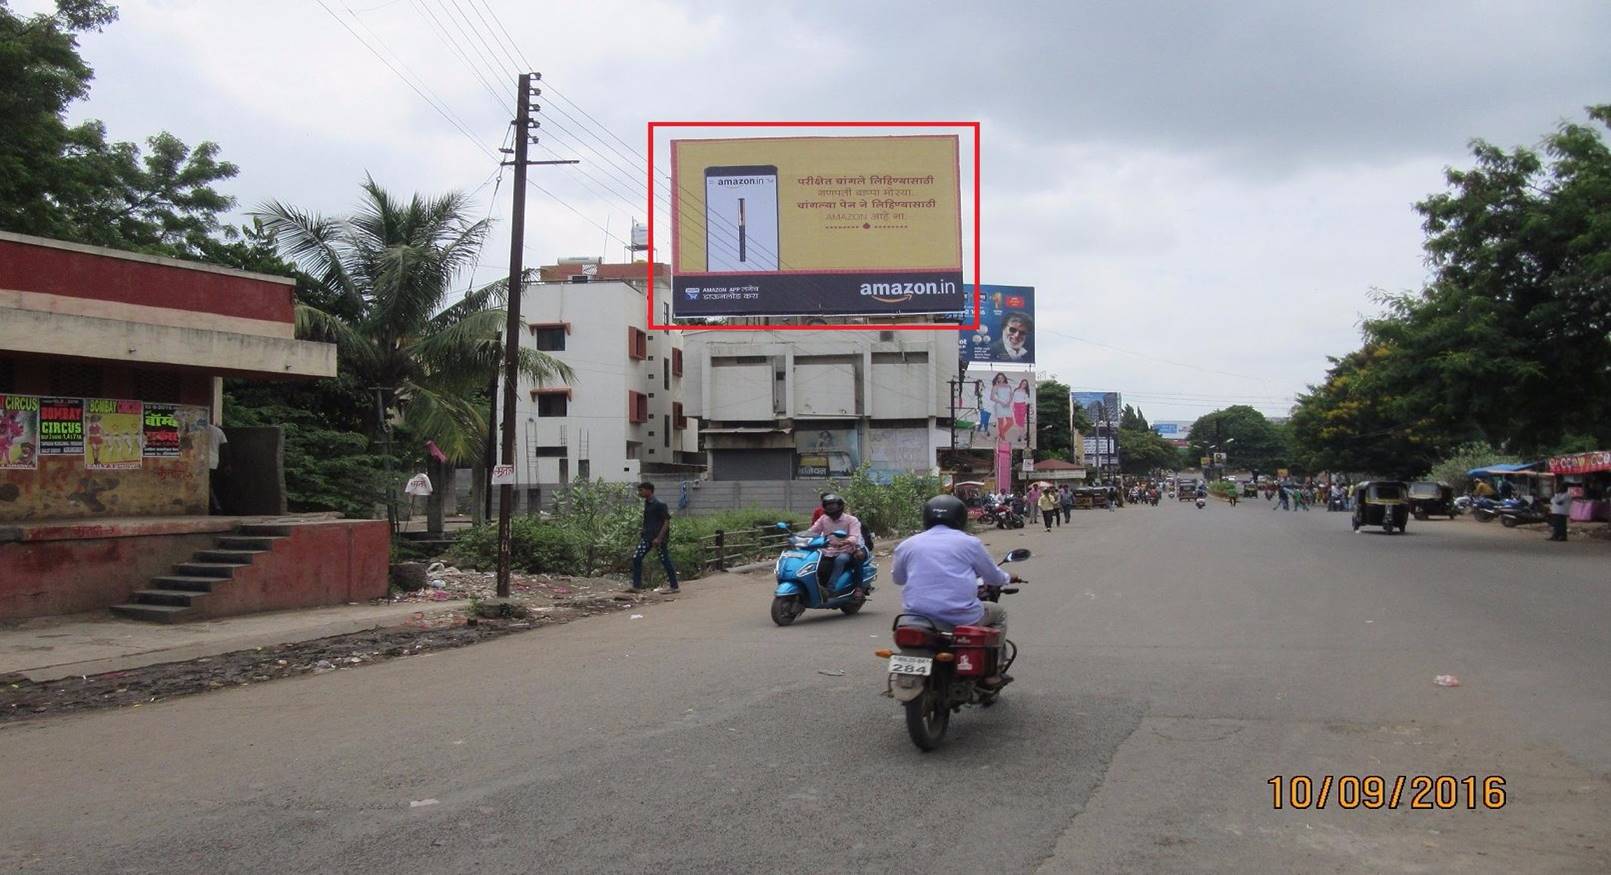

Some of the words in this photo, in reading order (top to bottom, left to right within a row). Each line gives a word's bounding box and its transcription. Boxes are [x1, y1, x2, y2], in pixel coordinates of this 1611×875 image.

[718, 177, 764, 186] amazon.in
[798, 176, 833, 187] परीक्षेत
[836, 176, 866, 185] चांगले
[870, 175, 935, 185] लिहिण्यासाठी
[797, 200, 836, 209] चांगल्या
[840, 199, 855, 208] पेन
[859, 200, 867, 208] ने
[871, 199, 936, 209] लिहिण्यासाठी
[860, 279, 956, 296] amazon.in
[5, 396, 38, 411] CIRCUS
[41, 422, 82, 434] CIRCUS
[892, 663, 927, 674] 284
